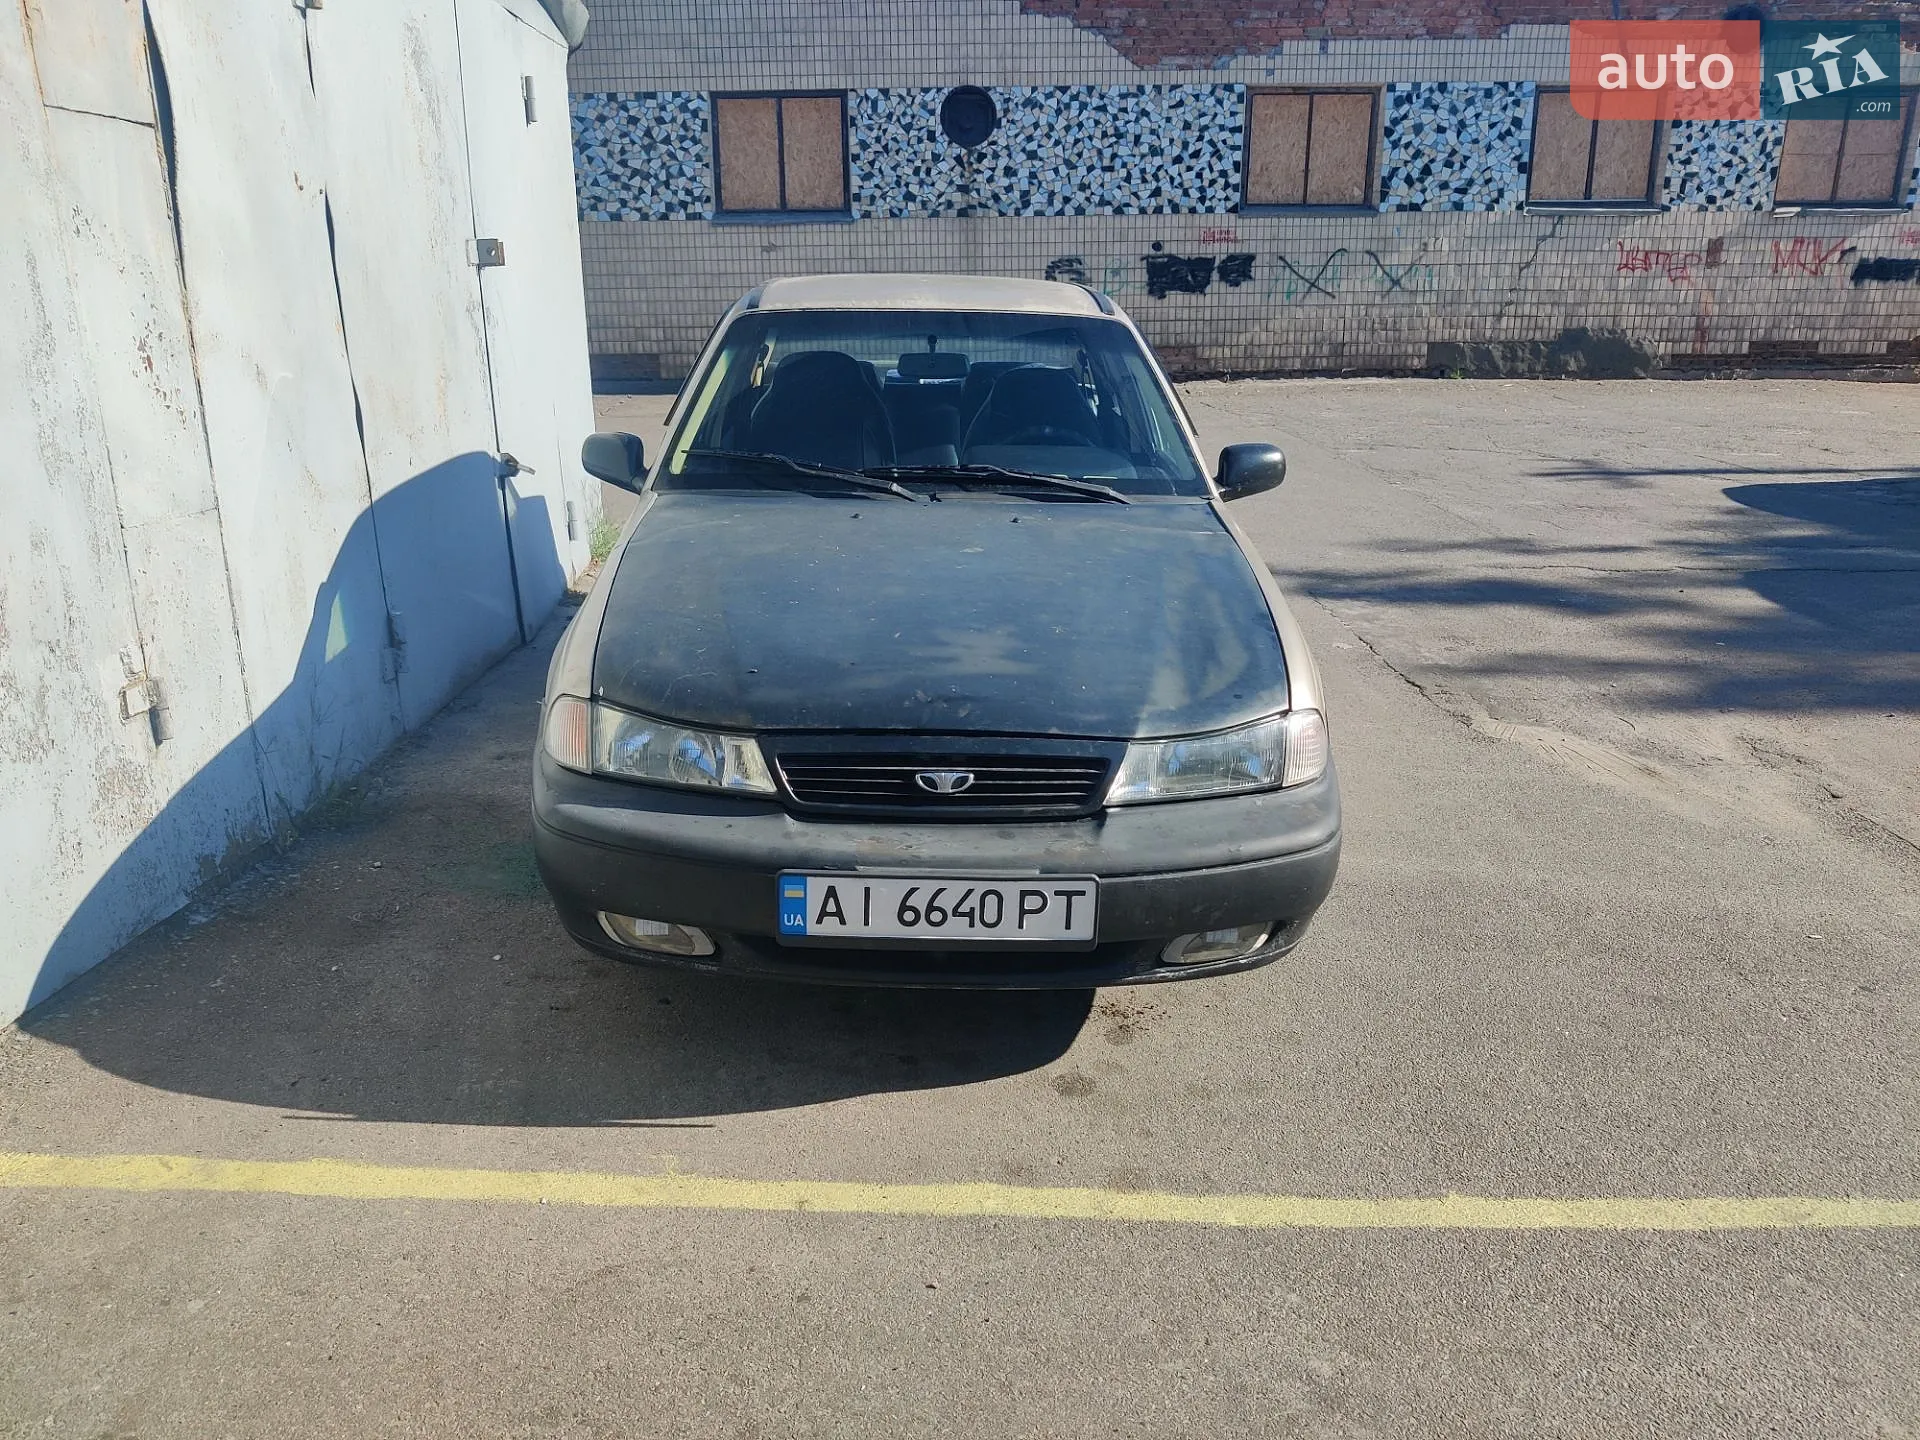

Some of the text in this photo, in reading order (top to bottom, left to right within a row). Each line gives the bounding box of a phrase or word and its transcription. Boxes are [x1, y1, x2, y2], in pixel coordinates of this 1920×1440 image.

[784, 913, 805, 927] UA
[815, 885, 1087, 930] AI 6640 PT
